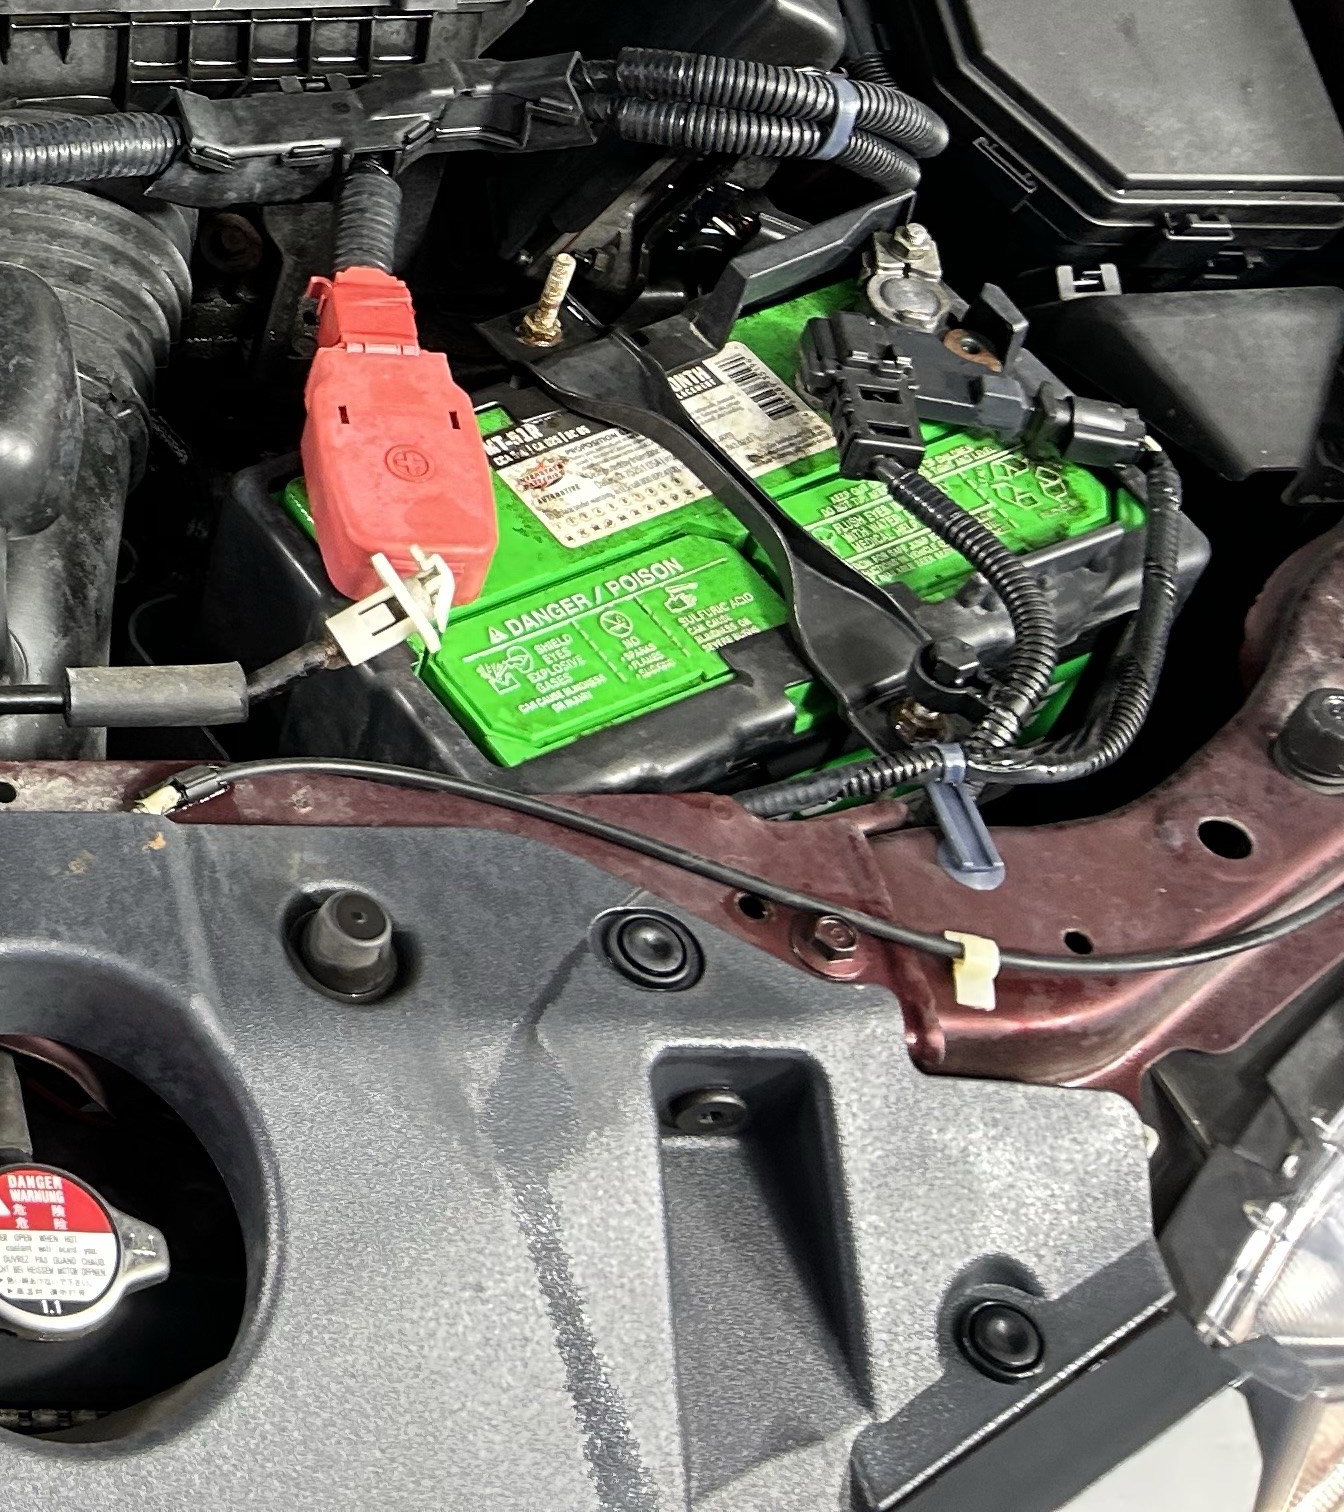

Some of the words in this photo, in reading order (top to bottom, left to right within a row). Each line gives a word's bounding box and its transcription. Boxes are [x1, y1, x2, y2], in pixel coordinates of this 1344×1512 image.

[666, 365, 711, 392] ONTH
[504, 594, 593, 638] DANGER
[606, 557, 684, 599] POISON
[677, 603, 730, 627] SULFURIC
[729, 592, 755, 611] ACID
[534, 634, 573, 655] SHIELD
[542, 648, 572, 665] EYES
[526, 654, 587, 683] EXPLOSIVE
[7, 1174, 63, 1189] DANGER
[41, 1299, 62, 1315] 1.1
